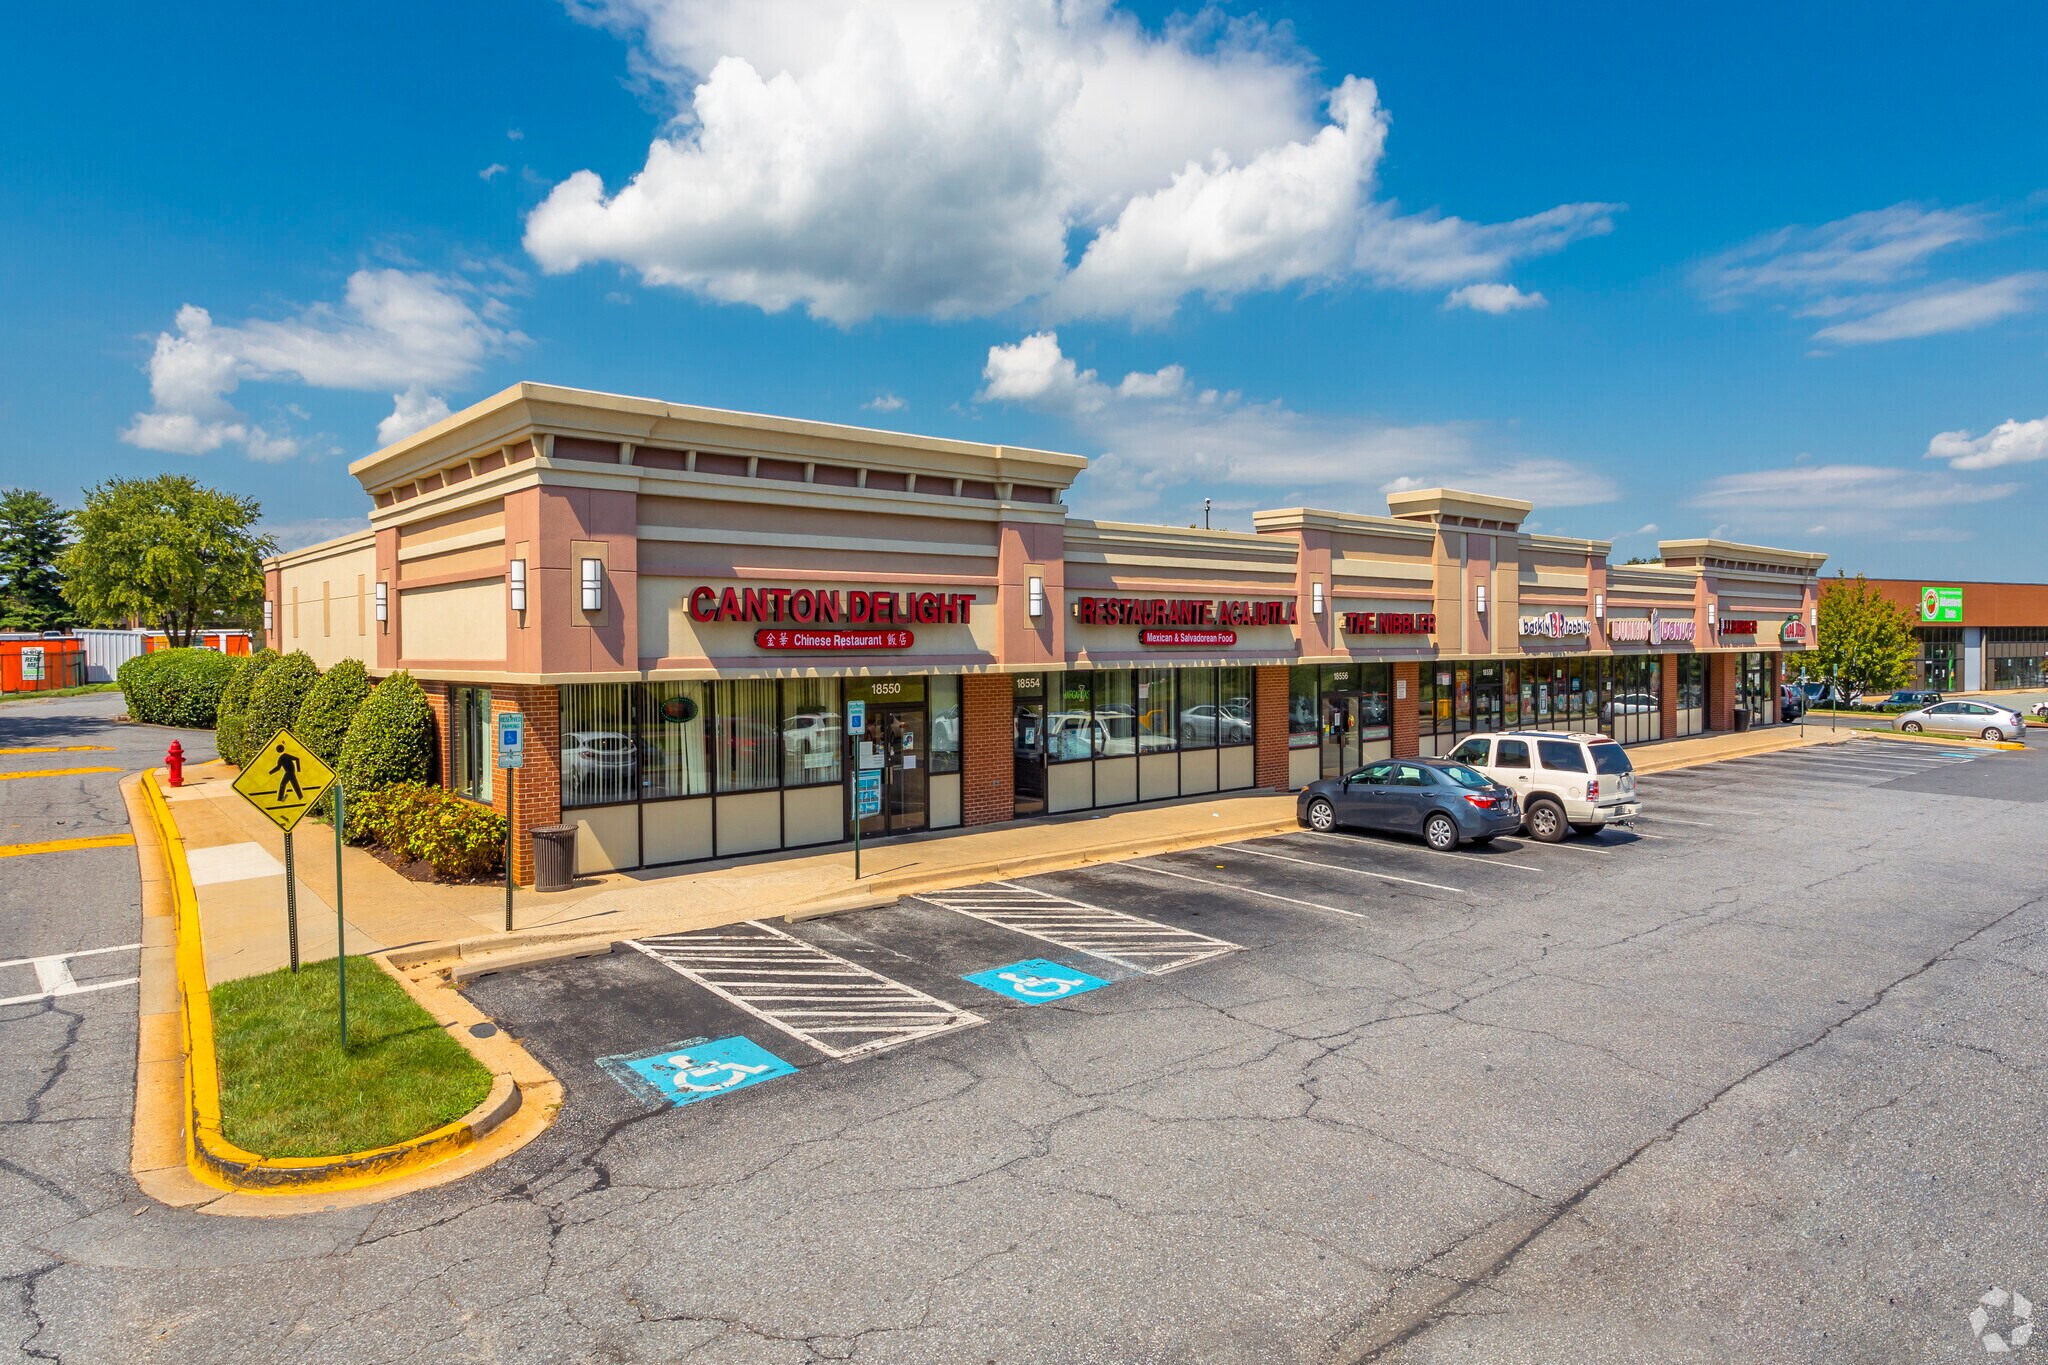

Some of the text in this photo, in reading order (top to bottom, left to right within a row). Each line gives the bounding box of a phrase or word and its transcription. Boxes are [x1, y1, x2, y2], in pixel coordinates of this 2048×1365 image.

[688, 586, 976, 625] CANTON DELIGHT
[1080, 597, 1298, 625] RESTAURANTE ACAJUTLA
[1346, 613, 1437, 634] THE NIBBLER
[1565, 619, 1591, 635] robbins
[1661, 621, 1696, 641] DONUTS
[794, 633, 832, 647] Chinese
[833, 634, 882, 647] Restaurant
[1146, 632, 1233, 643] Mexican & Salvadorean Food
[1333, 671, 1349, 680] 18556
[871, 682, 901, 695] 18550
[1016, 678, 1041, 689] 18554
